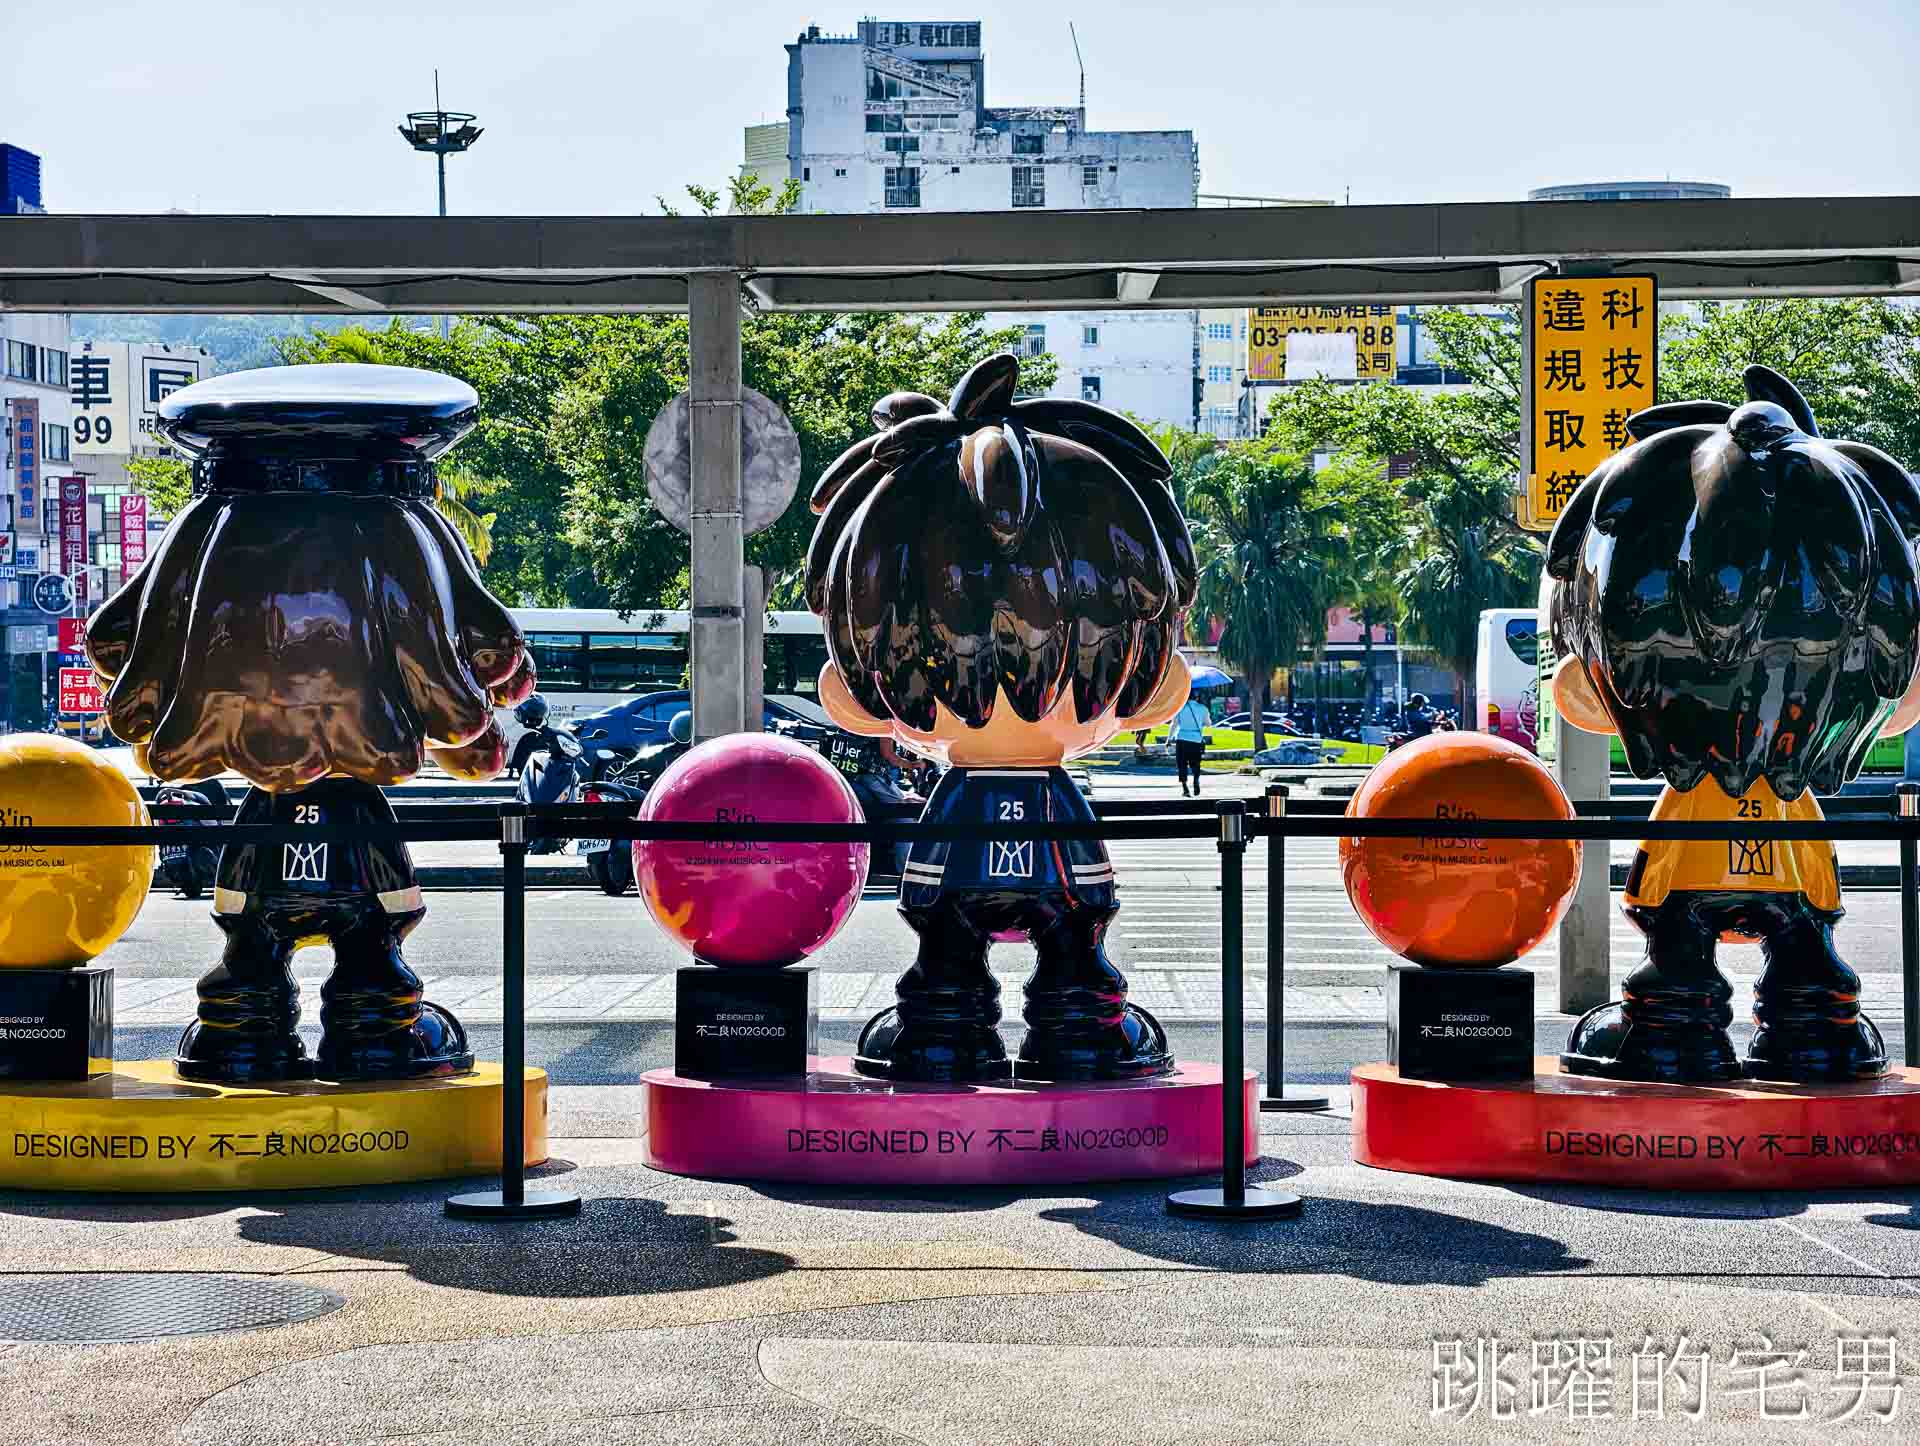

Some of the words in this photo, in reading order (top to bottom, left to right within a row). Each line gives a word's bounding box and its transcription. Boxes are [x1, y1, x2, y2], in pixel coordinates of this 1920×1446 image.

[1543, 289, 1586, 512] 違規取締
[74, 415, 112, 444] 99
[295, 805, 320, 824] 25
[1000, 801, 1024, 820] 25
[1738, 799, 1763, 818] 25
[1441, 1014, 1480, 1022] DESIGNED
[1480, 1014, 1490, 1022] BY
[14, 1133, 148, 1159] DESIGNED
[157, 1134, 196, 1159] BY
[787, 1129, 928, 1153] DESIGNED
[937, 1131, 976, 1153] BY
[1545, 1131, 1698, 1159] DESIGNED
[1707, 1135, 1746, 1160] BY
